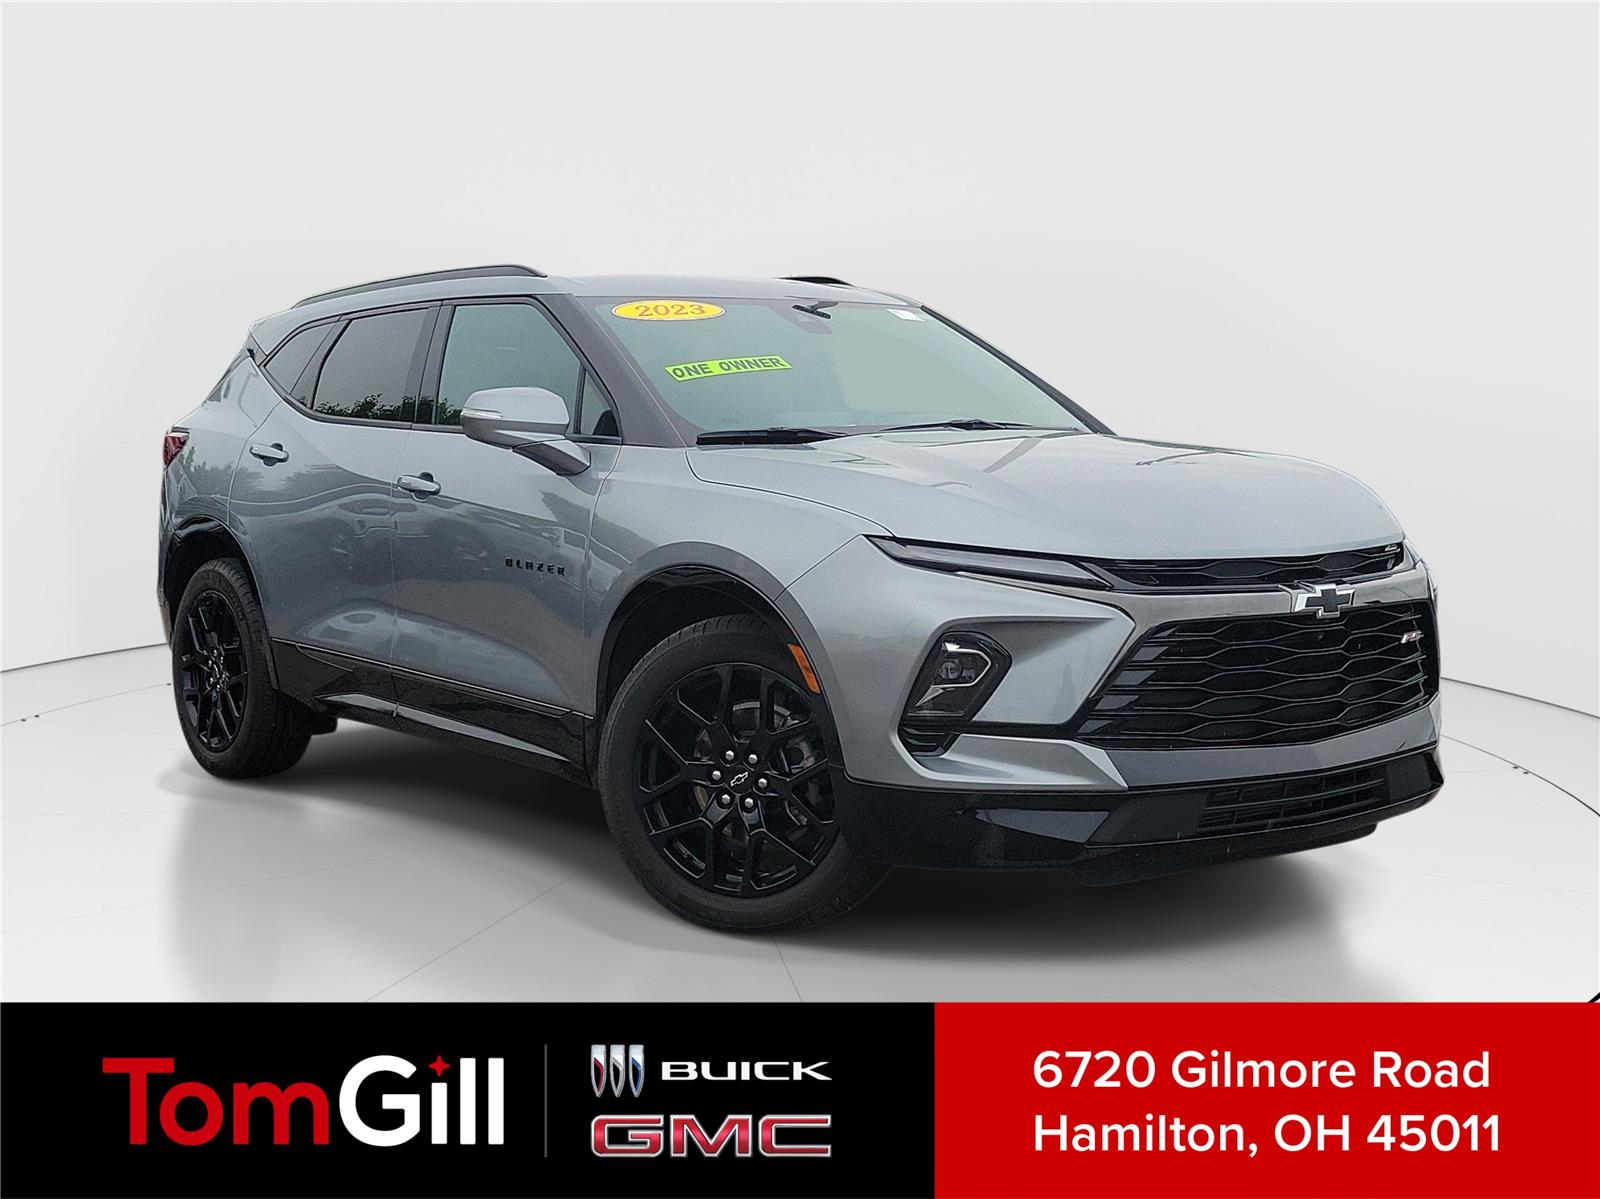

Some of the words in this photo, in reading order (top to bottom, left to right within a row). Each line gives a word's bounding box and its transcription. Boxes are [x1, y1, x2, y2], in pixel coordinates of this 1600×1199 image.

[635, 303, 706, 317] 2023
[672, 363, 711, 379] ONE
[719, 357, 784, 372] OWNER
[505, 558, 566, 576] BLAZER
